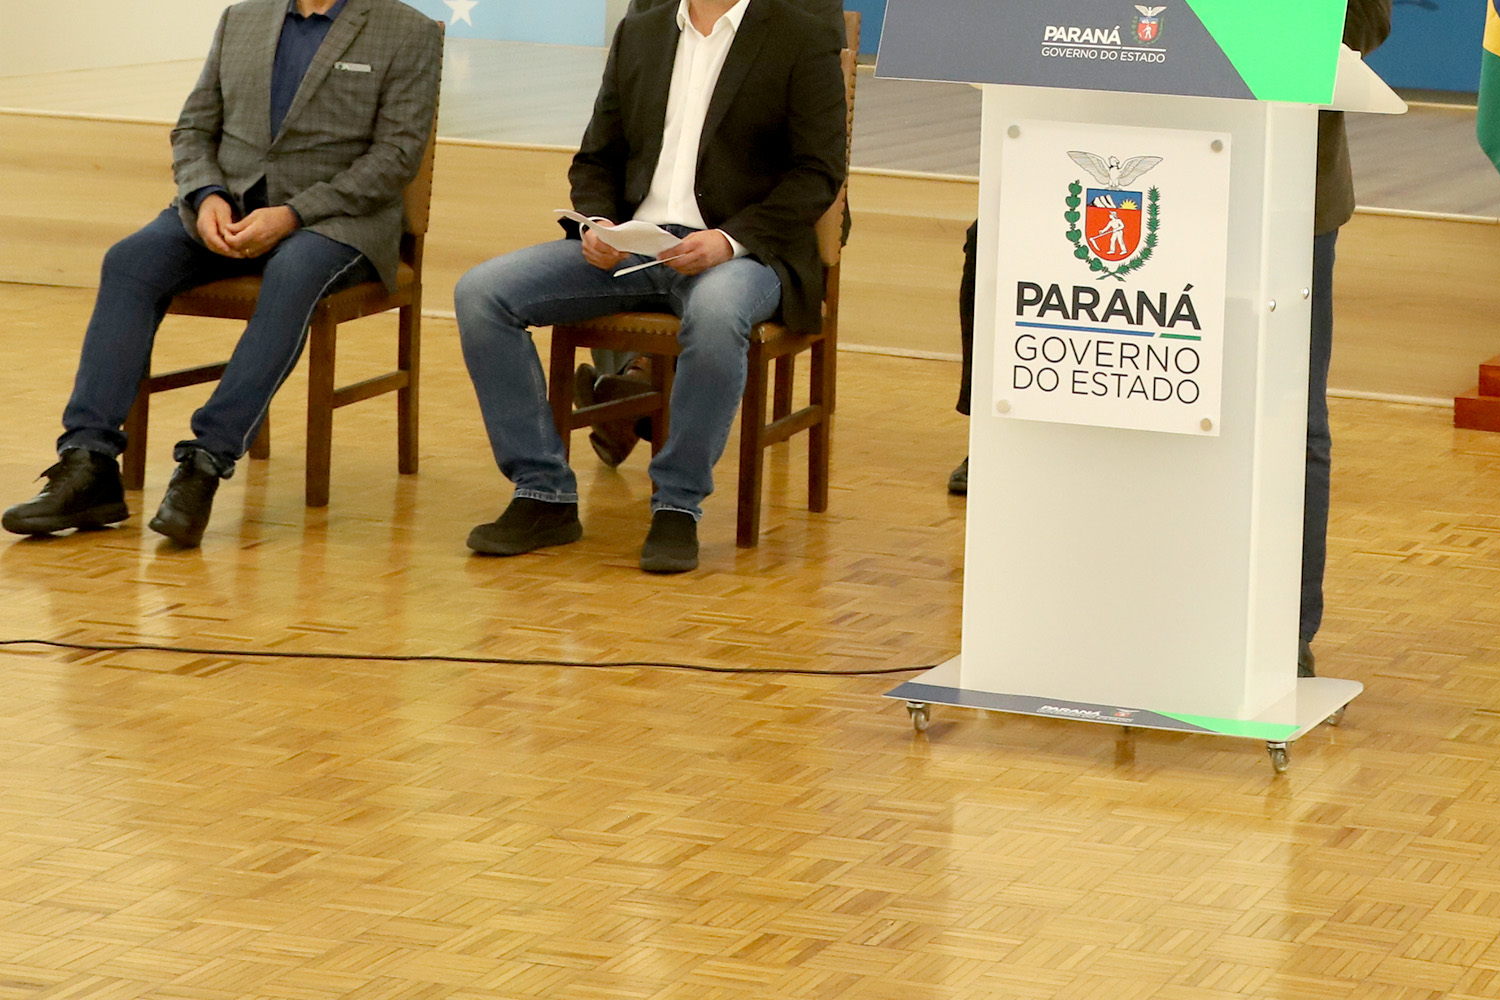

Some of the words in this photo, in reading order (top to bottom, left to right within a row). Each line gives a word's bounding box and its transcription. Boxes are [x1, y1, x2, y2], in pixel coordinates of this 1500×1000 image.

[1043, 25, 1121, 45] PARANÁ
[1041, 46, 1098, 60] GOVERNO
[1100, 50, 1118, 61] DO
[1120, 51, 1166, 64] ESTADO
[1016, 281, 1202, 331] PARANÁ
[1014, 334, 1200, 374] GOVERNO
[1013, 365, 1059, 392] DO
[1072, 370, 1200, 404] ESTADO
